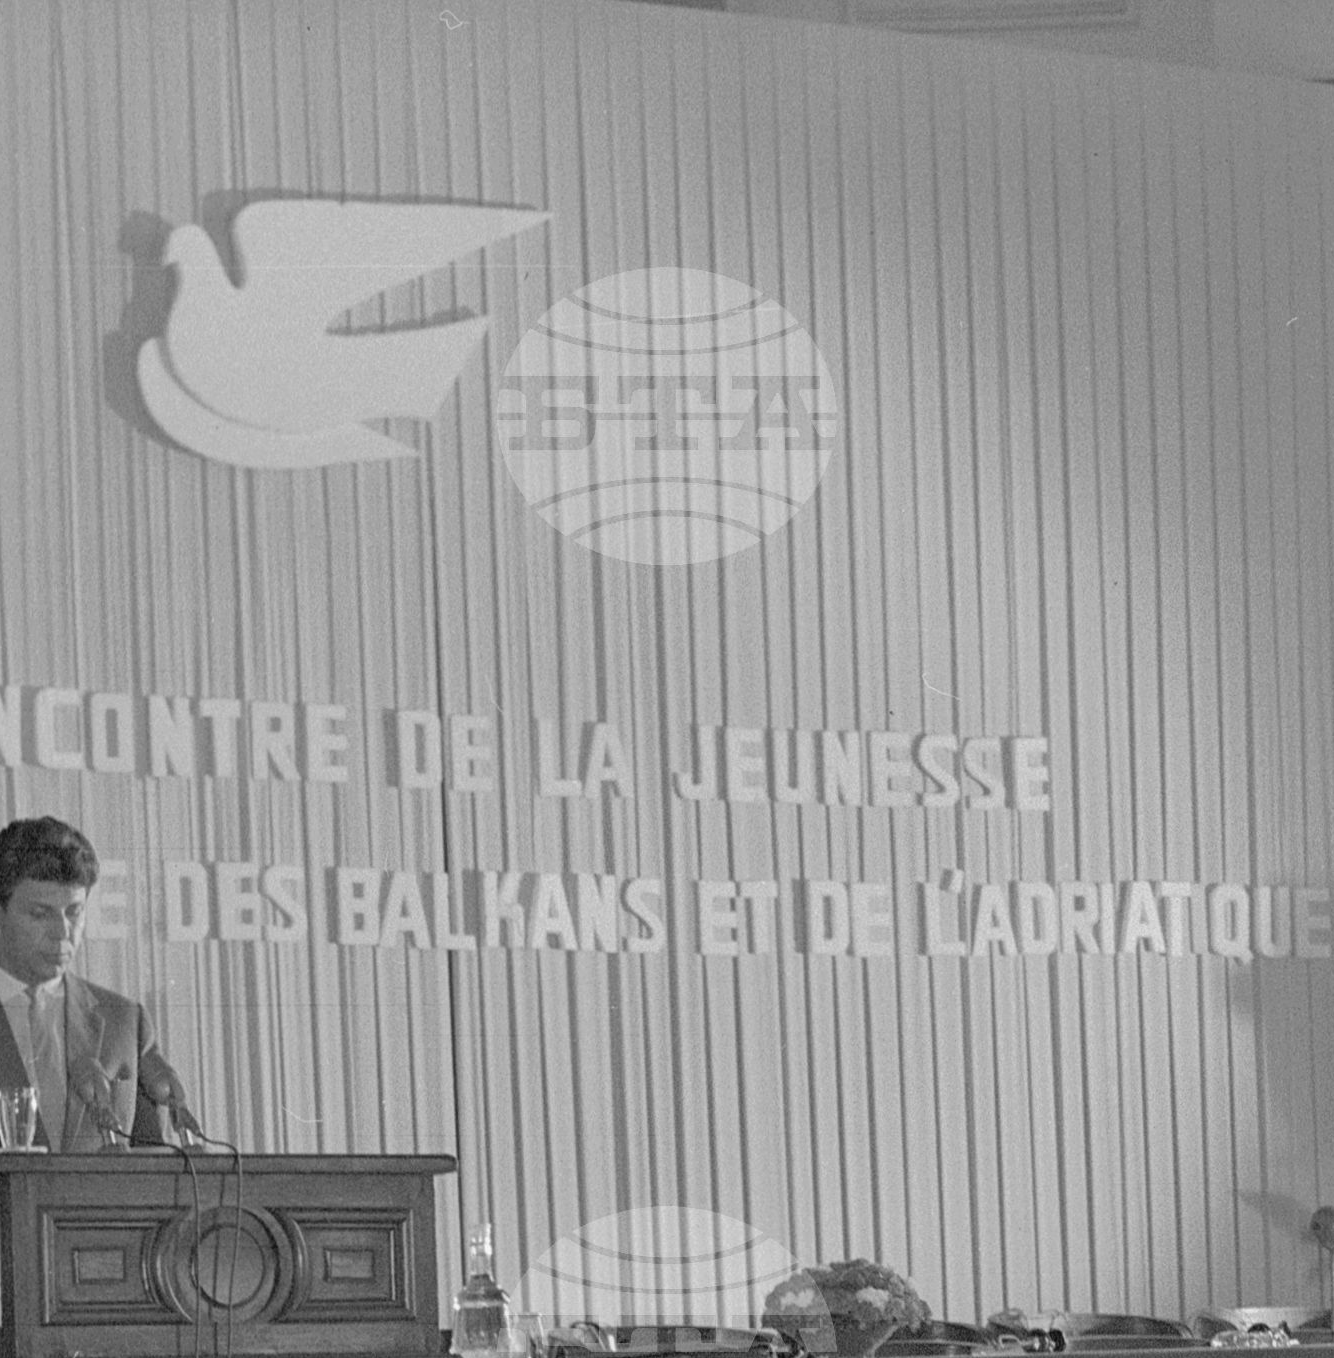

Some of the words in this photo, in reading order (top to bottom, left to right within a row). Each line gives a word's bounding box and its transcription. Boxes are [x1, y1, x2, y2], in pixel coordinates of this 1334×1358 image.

[397, 708, 493, 792] DE
[537, 718, 629, 798] LA
[673, 725, 1051, 811] JEUNESSE
[168, 861, 307, 942] DES
[339, 868, 664, 953] BALKANS
[699, 879, 779, 956] ET
[809, 881, 893, 957] DE
